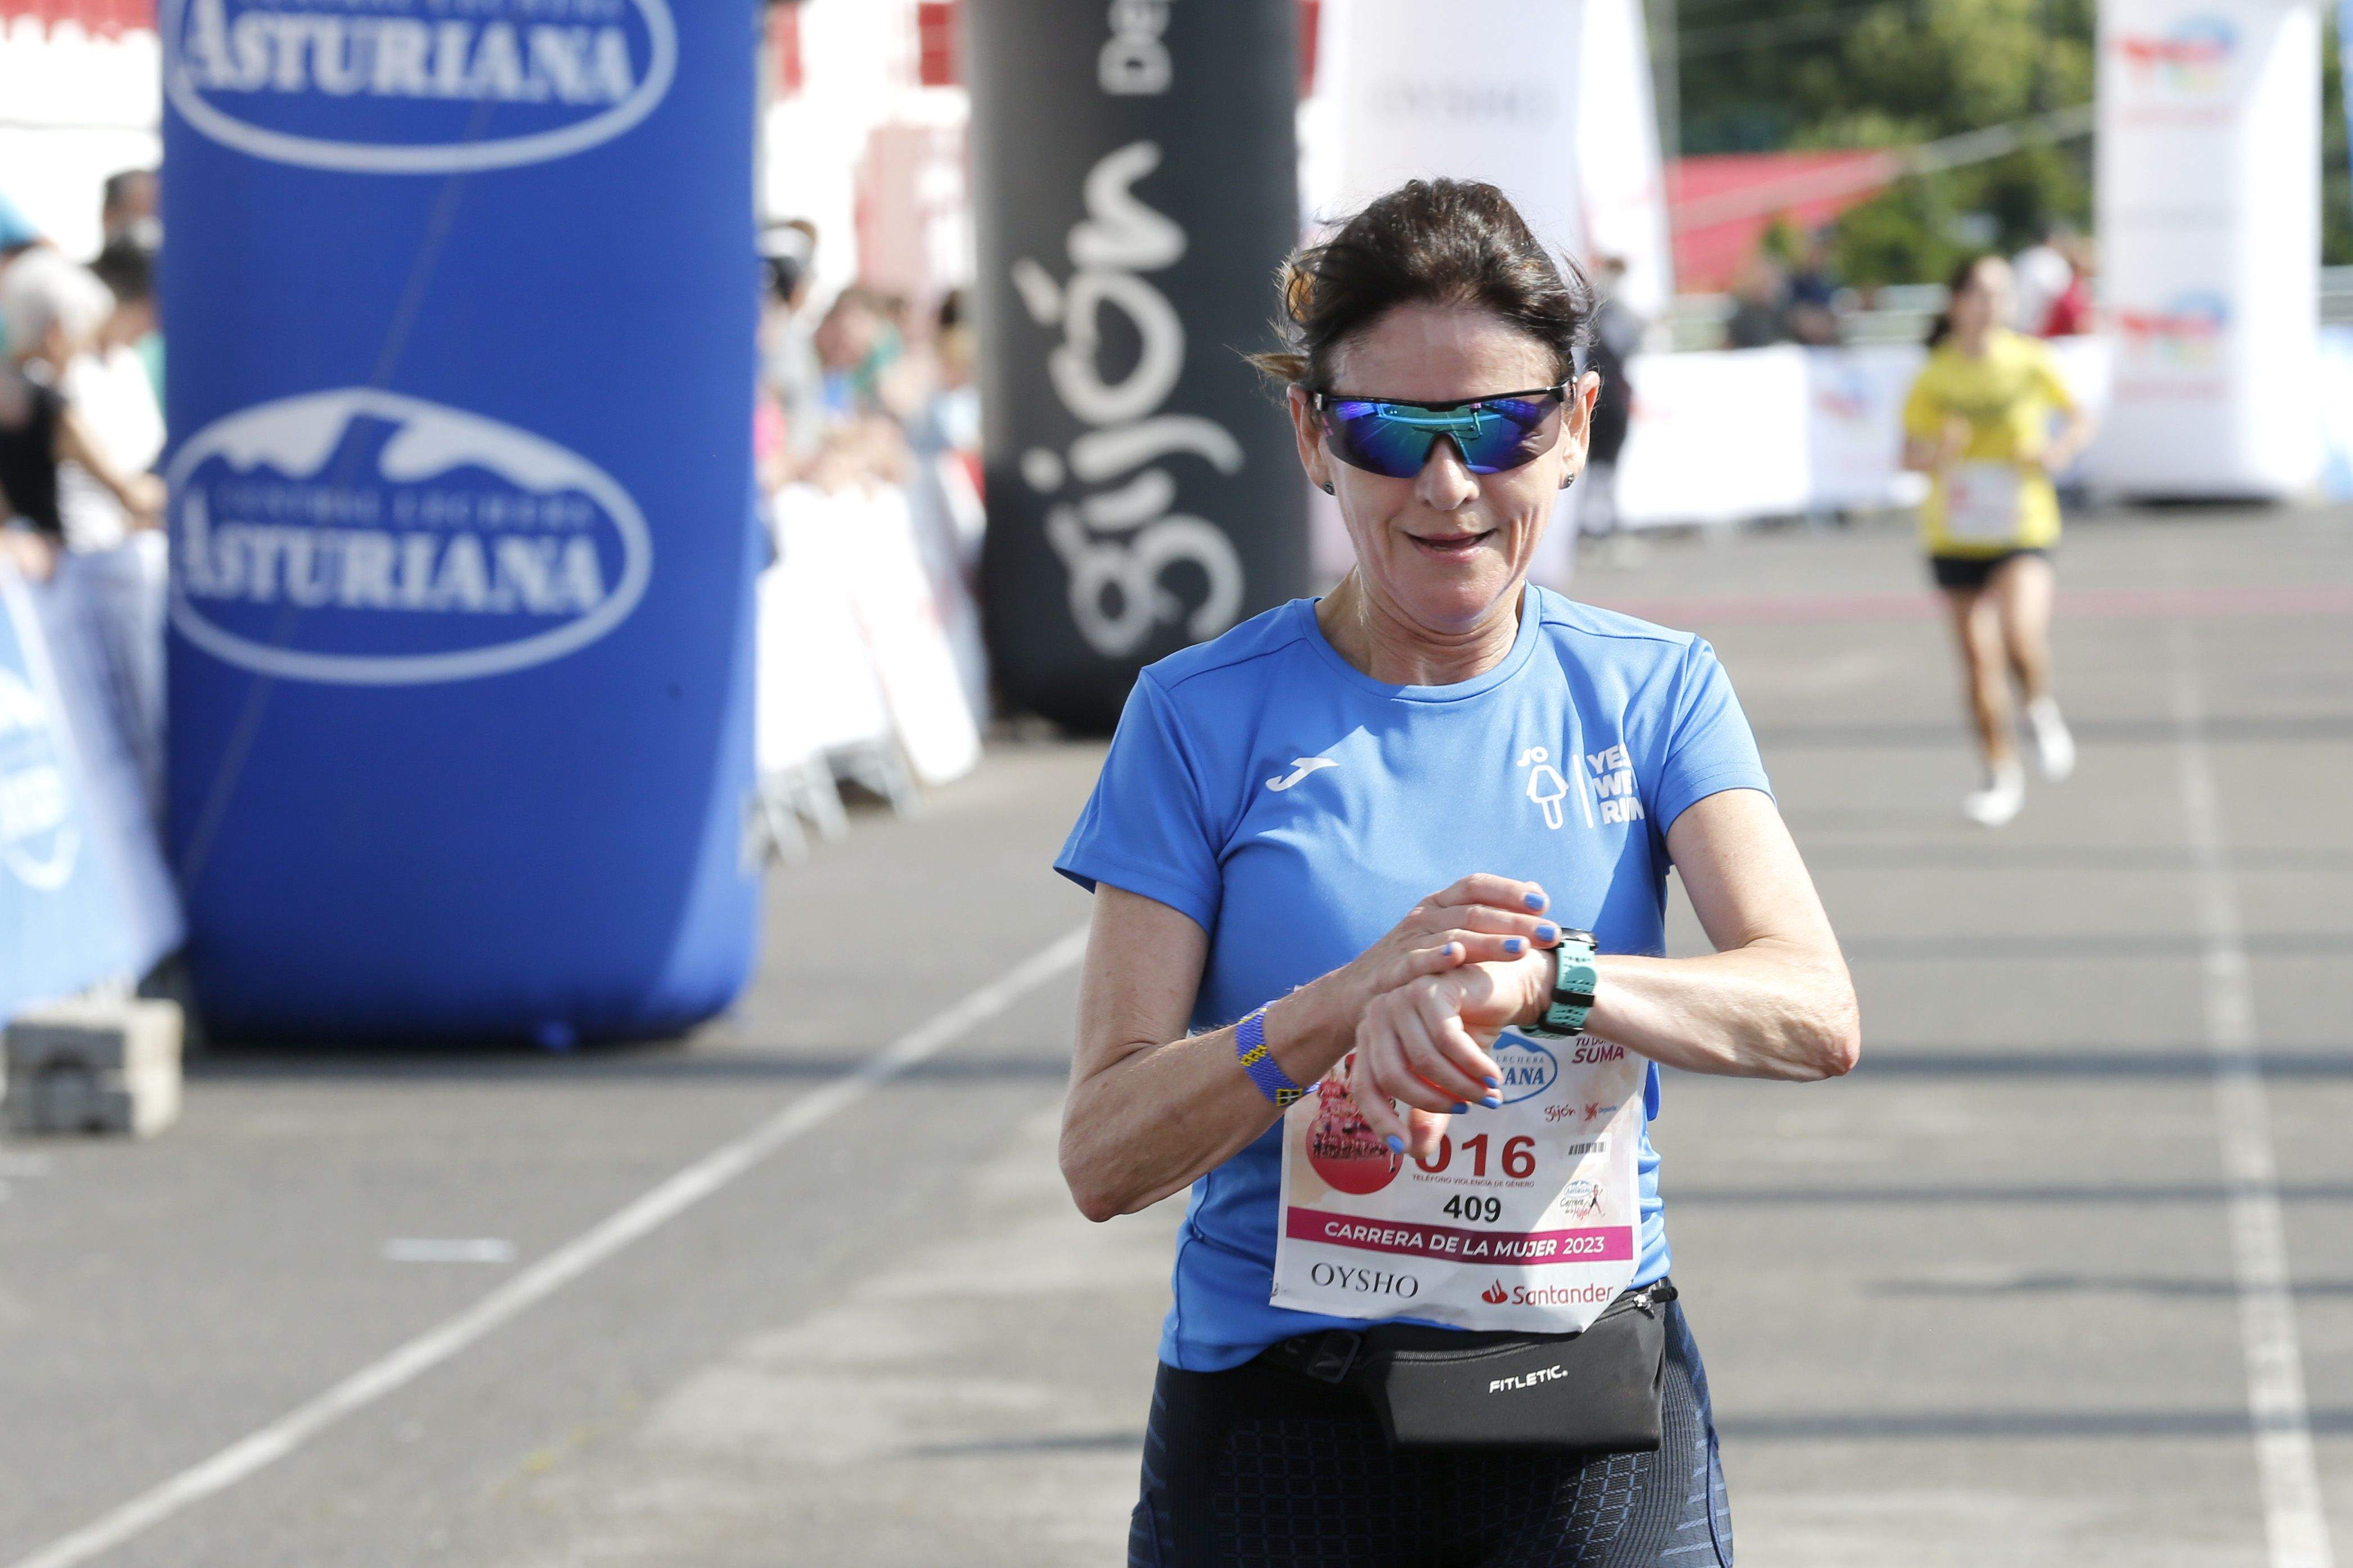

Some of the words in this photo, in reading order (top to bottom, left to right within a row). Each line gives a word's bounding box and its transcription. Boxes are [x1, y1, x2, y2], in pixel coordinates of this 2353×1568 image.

[185, 0, 636, 105] ASTURIANA
[181, 488, 607, 615] ASTURIANA
[1600, 797, 1645, 825] RUN
[1572, 1044, 1624, 1063] SUMA
[1545, 1104, 1576, 1122] gijón
[1415, 1133, 1536, 1180] 016
[1412, 1174, 1452, 1184] TELÉFONO
[1454, 1177, 1493, 1187] VIOLENCIA
[1443, 1194, 1502, 1223] 409
[1324, 1221, 1423, 1248] CARRERA
[1429, 1234, 1461, 1254] DE
[1462, 1238, 1489, 1257] LA
[1494, 1238, 1558, 1258] MUJER
[1562, 1235, 1606, 1256] 2023
[1311, 1262, 1418, 1299] OYSHO
[1512, 1282, 1614, 1306] Santander
